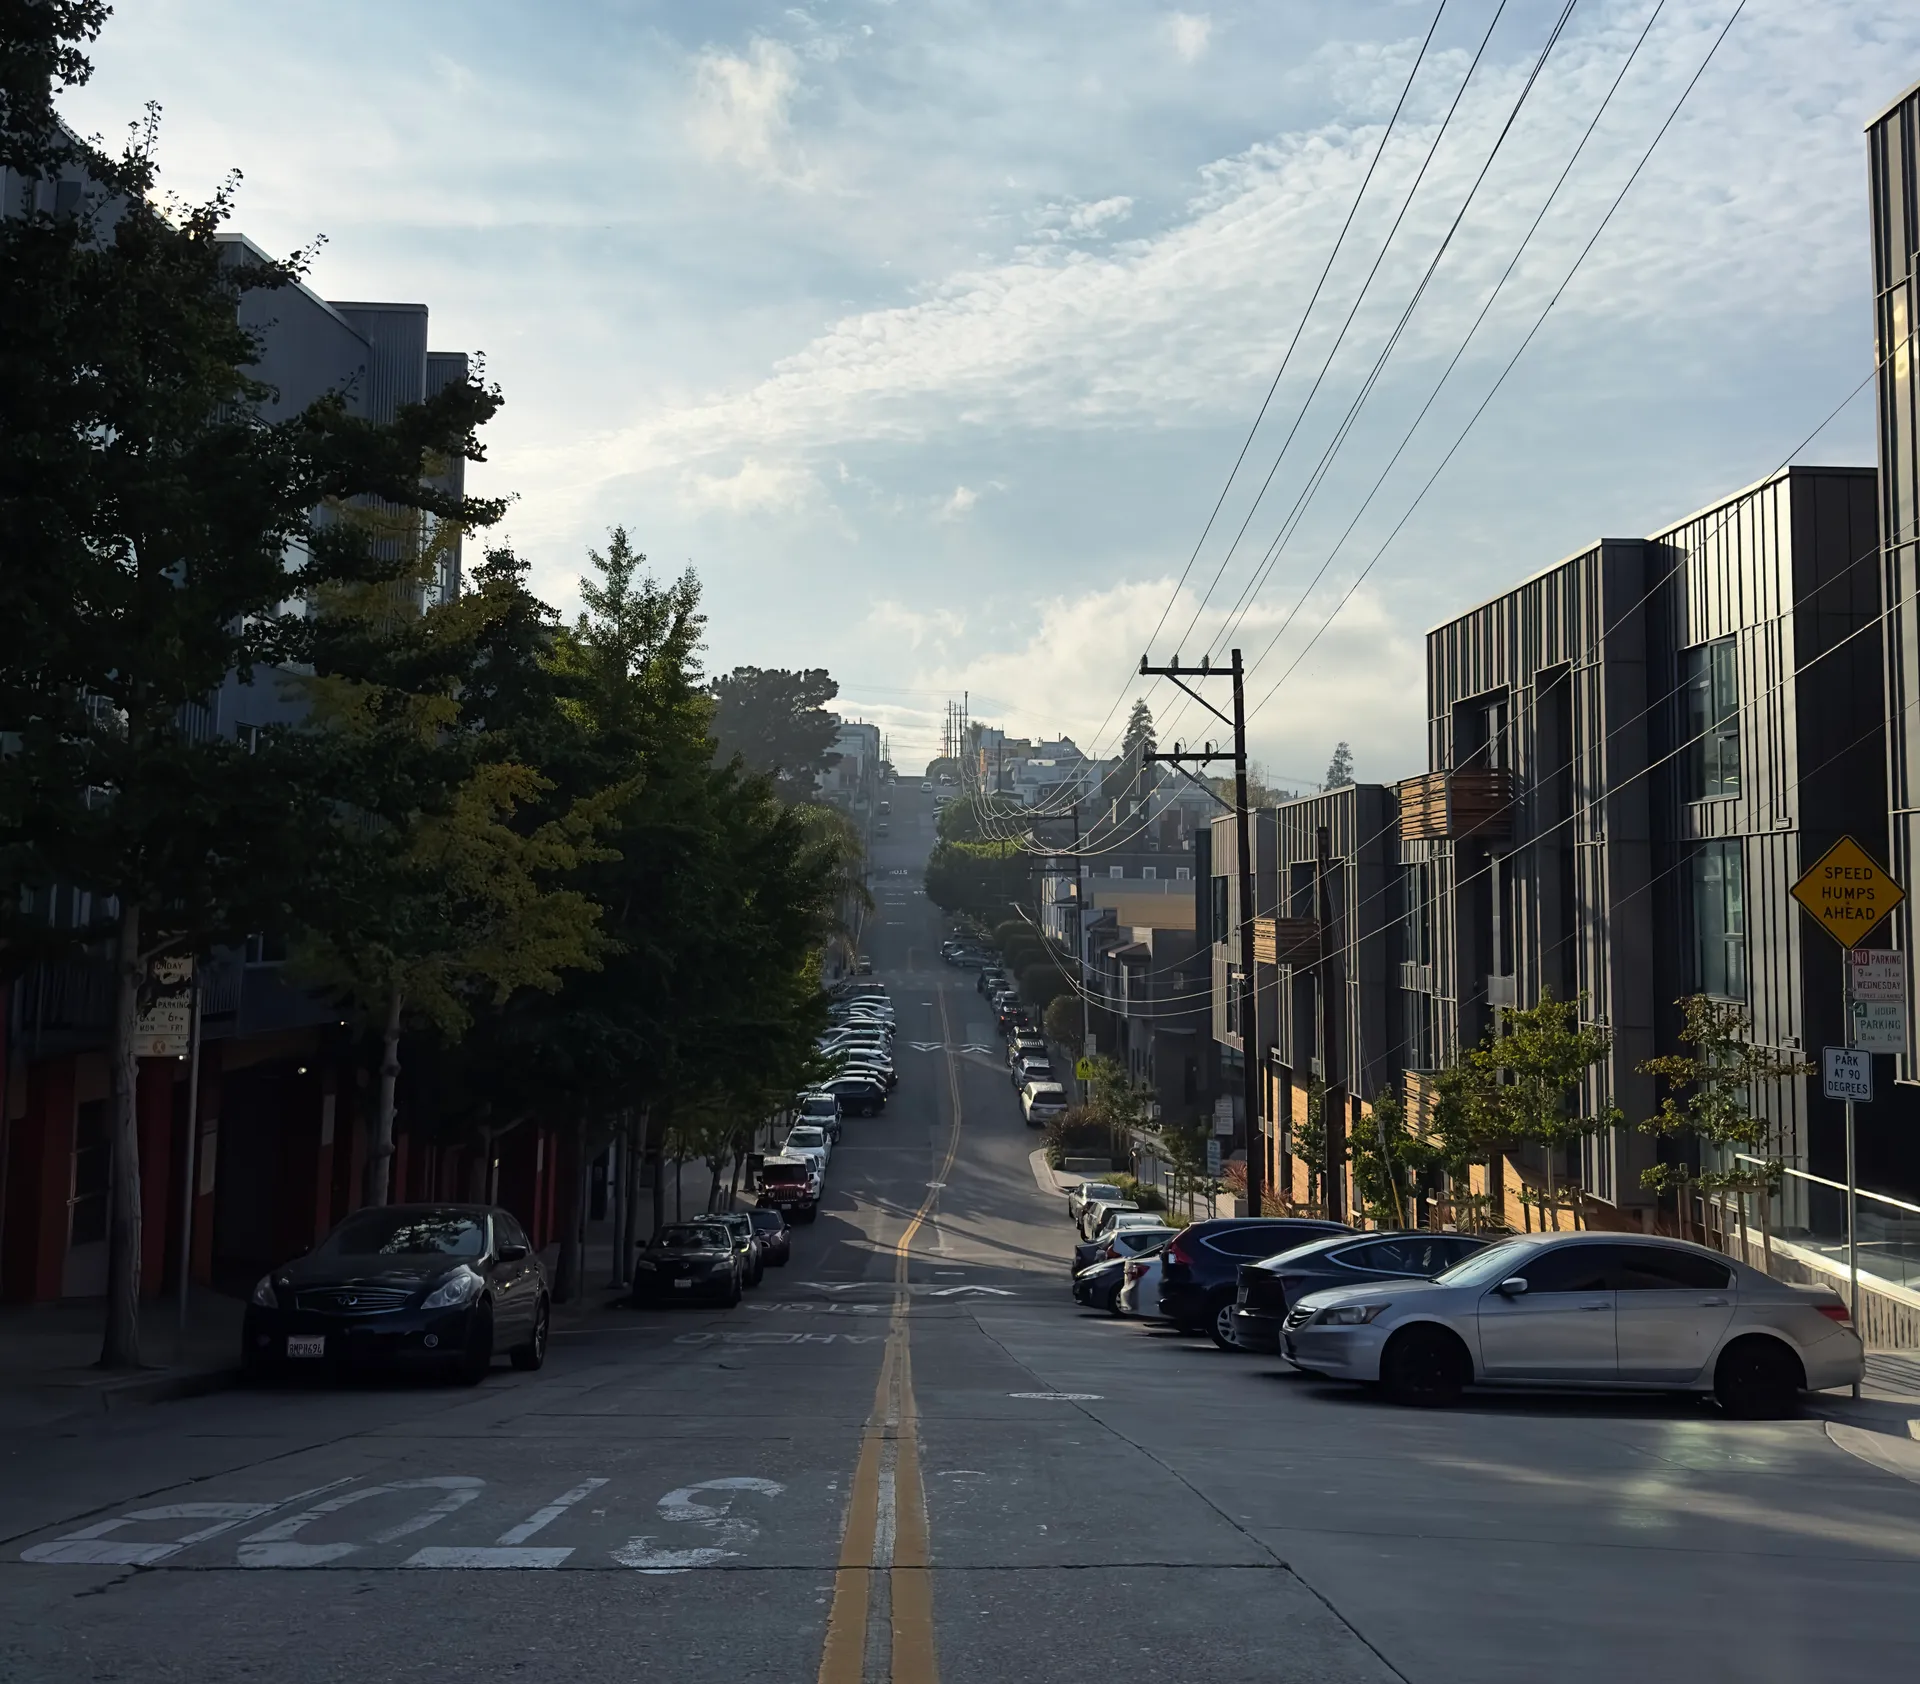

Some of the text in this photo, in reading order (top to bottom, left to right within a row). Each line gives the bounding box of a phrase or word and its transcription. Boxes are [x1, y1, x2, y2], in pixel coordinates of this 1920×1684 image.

[1824, 867, 1873, 880] SPEED
[1822, 886, 1875, 900] HUMPS
[1823, 906, 1875, 920] AHEAD
[1854, 951, 1901, 965] NO PARKING
[1857, 980, 1901, 990] WEDNESDAY
[1855, 1004, 1897, 1016] 4 HOUR
[170, 1023, 183, 1032] FRI
[1860, 1019, 1901, 1030] PARKING
[1835, 1054, 1858, 1066] PARK
[1834, 1068, 1860, 1080] AT 90
[1828, 1081, 1868, 1094] DEGREES
[745, 1303, 880, 1313] STOP
[20, 1475, 786, 1575] STOP
